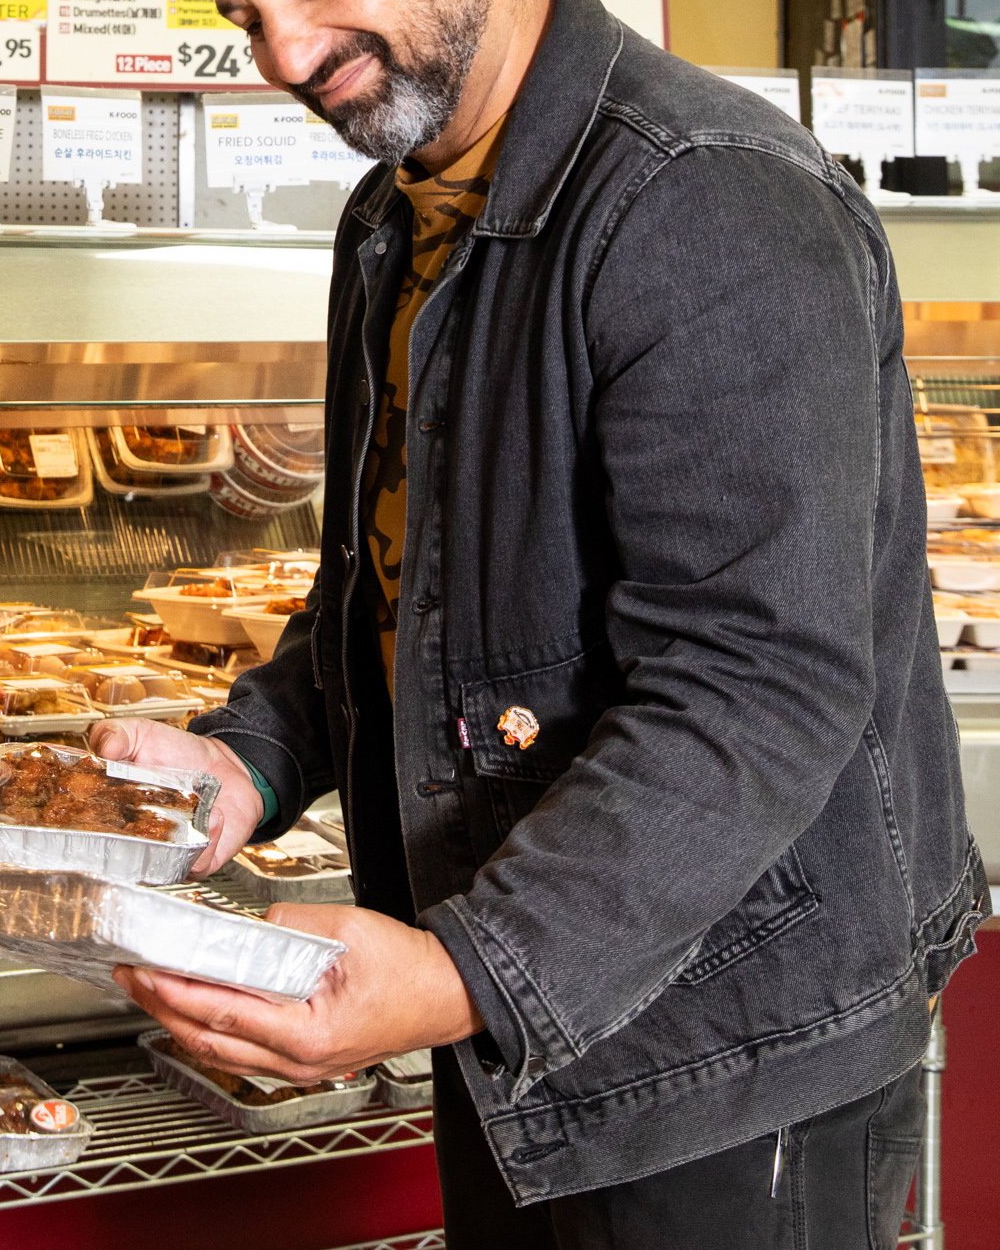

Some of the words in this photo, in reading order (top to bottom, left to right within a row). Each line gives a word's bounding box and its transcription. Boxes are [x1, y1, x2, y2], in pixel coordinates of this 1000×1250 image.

[117, 56, 133, 71] 12
[135, 57, 171, 73] Piece
[48, 108, 74, 116] KUKJE
[53, 128, 85, 140] BONELESS
[86, 130, 104, 141] FRIED
[105, 130, 133, 141] CHICKEN
[218, 137, 253, 147] FRIED
[257, 136, 296, 147] SQUID
[54, 147, 73, 159] 순살
[76, 148, 132, 160] 후라이드치킨
[234, 155, 283, 166] 오징어튀김
